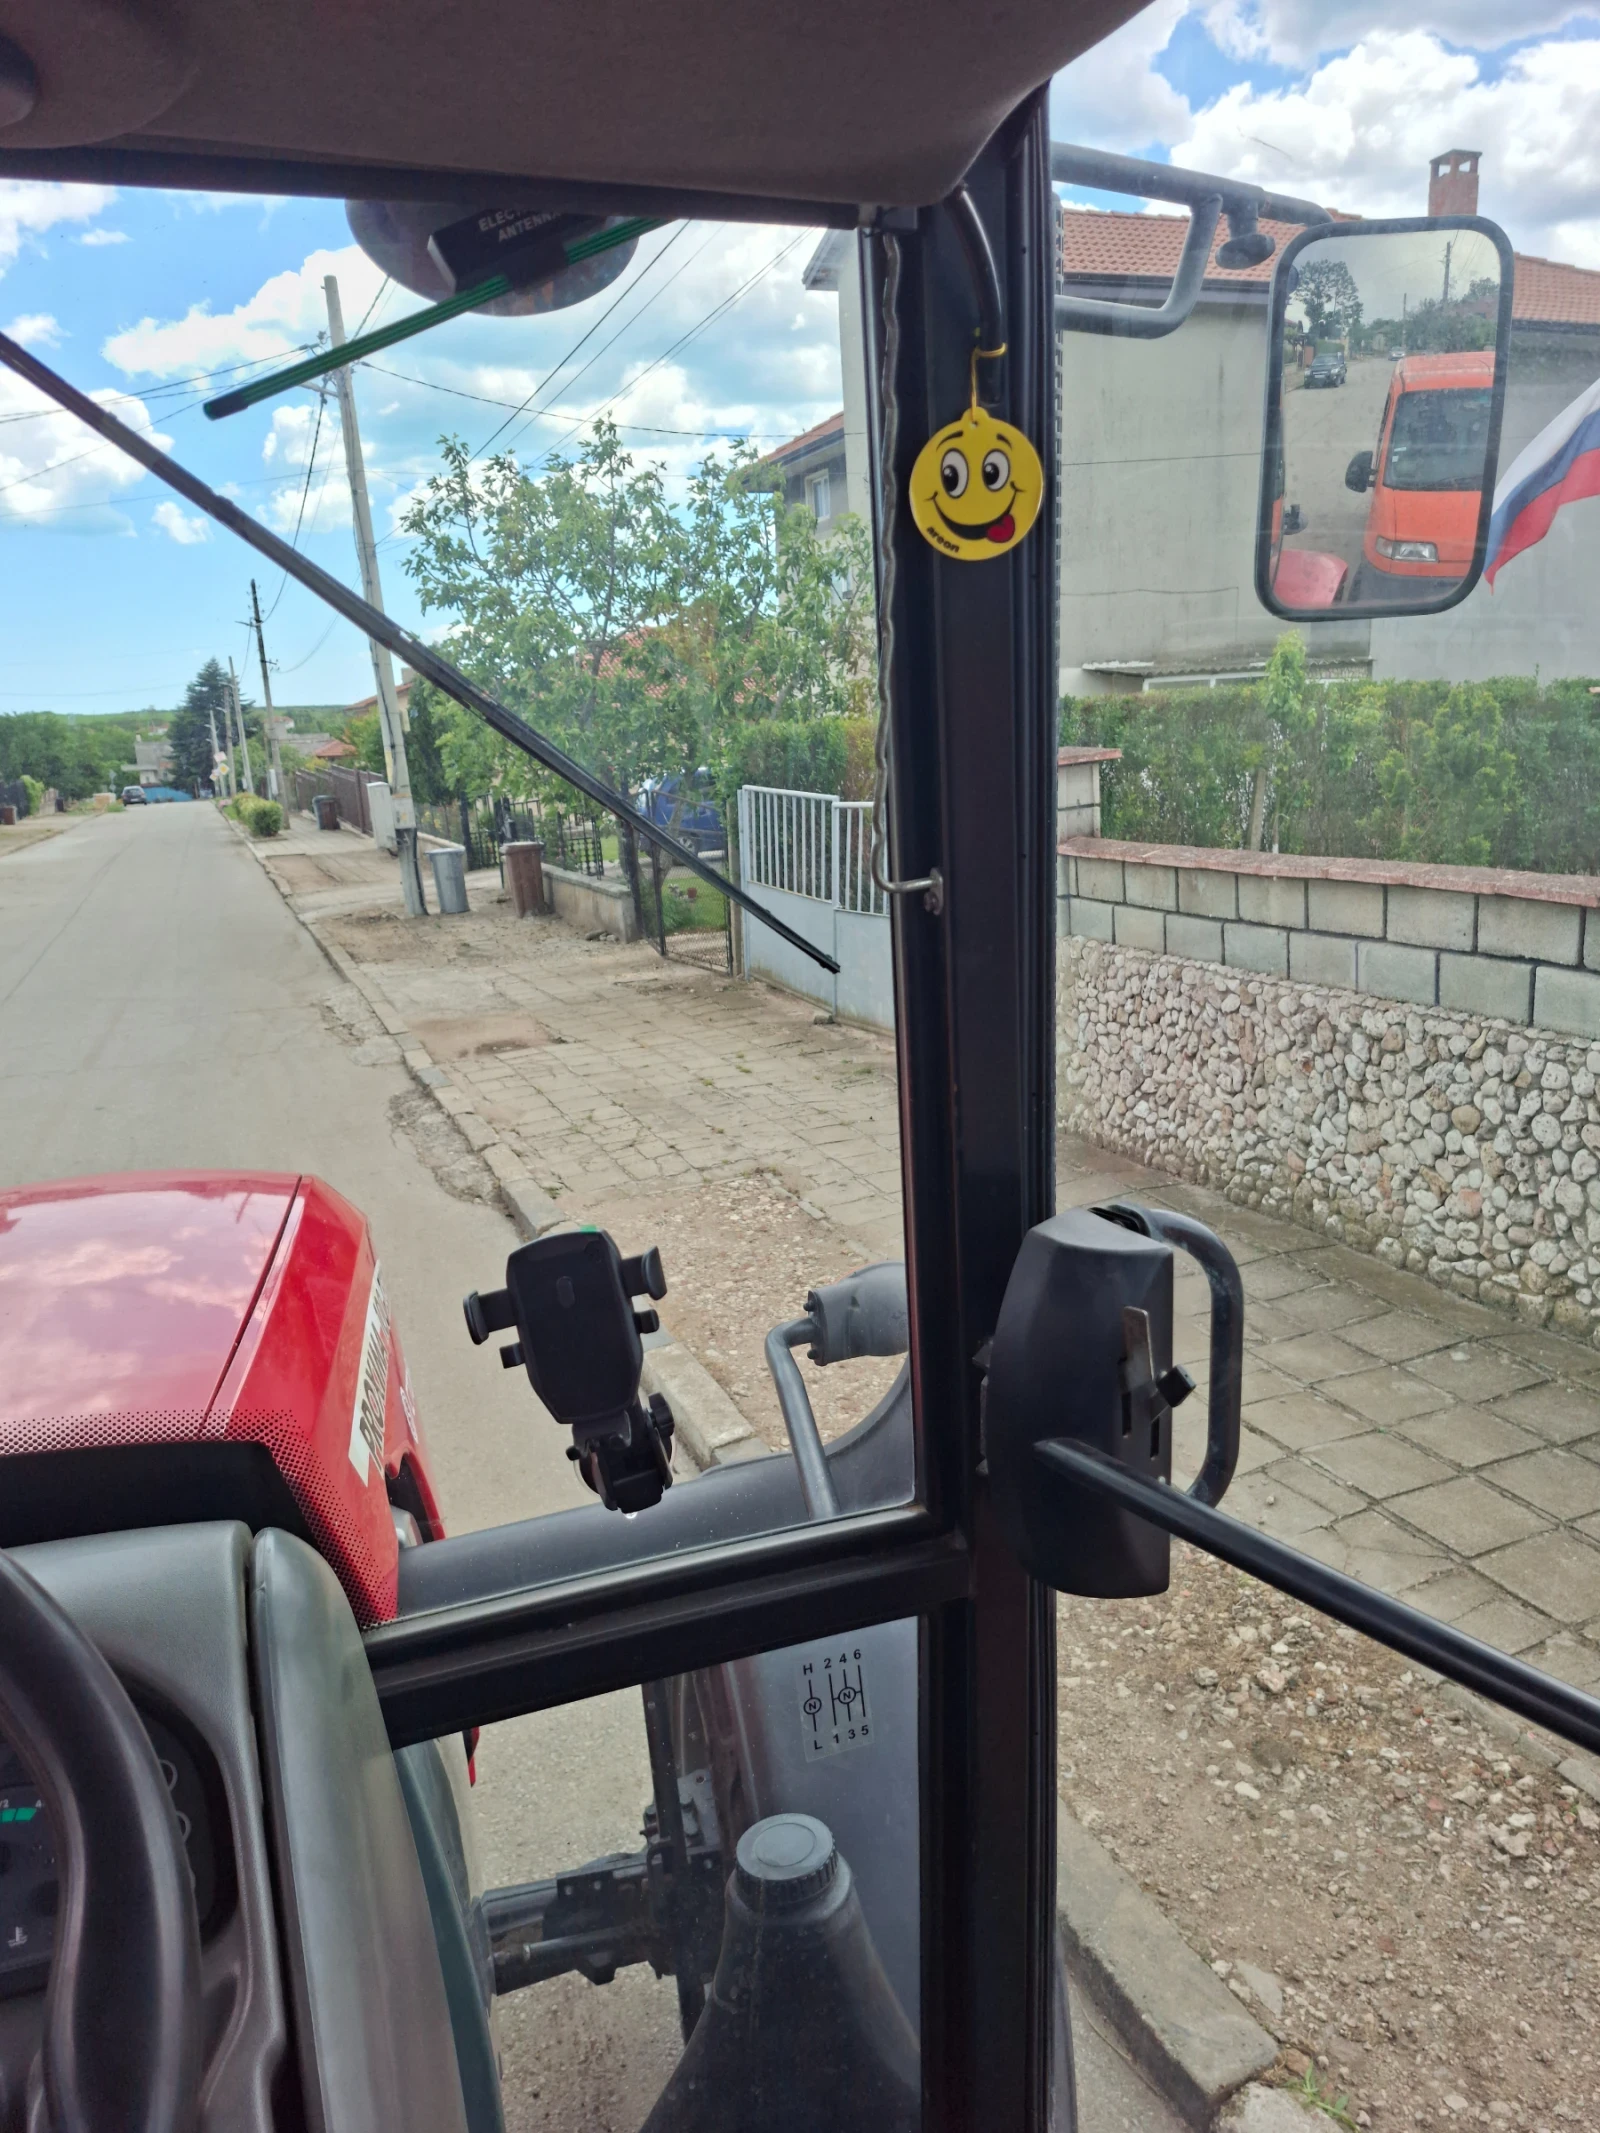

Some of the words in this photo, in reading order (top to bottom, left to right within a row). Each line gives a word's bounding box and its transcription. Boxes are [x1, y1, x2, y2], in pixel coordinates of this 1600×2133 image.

[926, 526, 960, 553] areon
[803, 1662, 813, 1676] H
[823, 1657, 832, 1669] 2
[839, 1653, 848, 1664] 4
[853, 1648, 862, 1660] 6
[808, 1701, 817, 1711] N
[843, 1690, 851, 1701] N
[813, 1739, 823, 1750] L
[833, 1733, 840, 1744] 1
[848, 1728, 856, 1740] 3
[861, 1724, 869, 1736] 5
